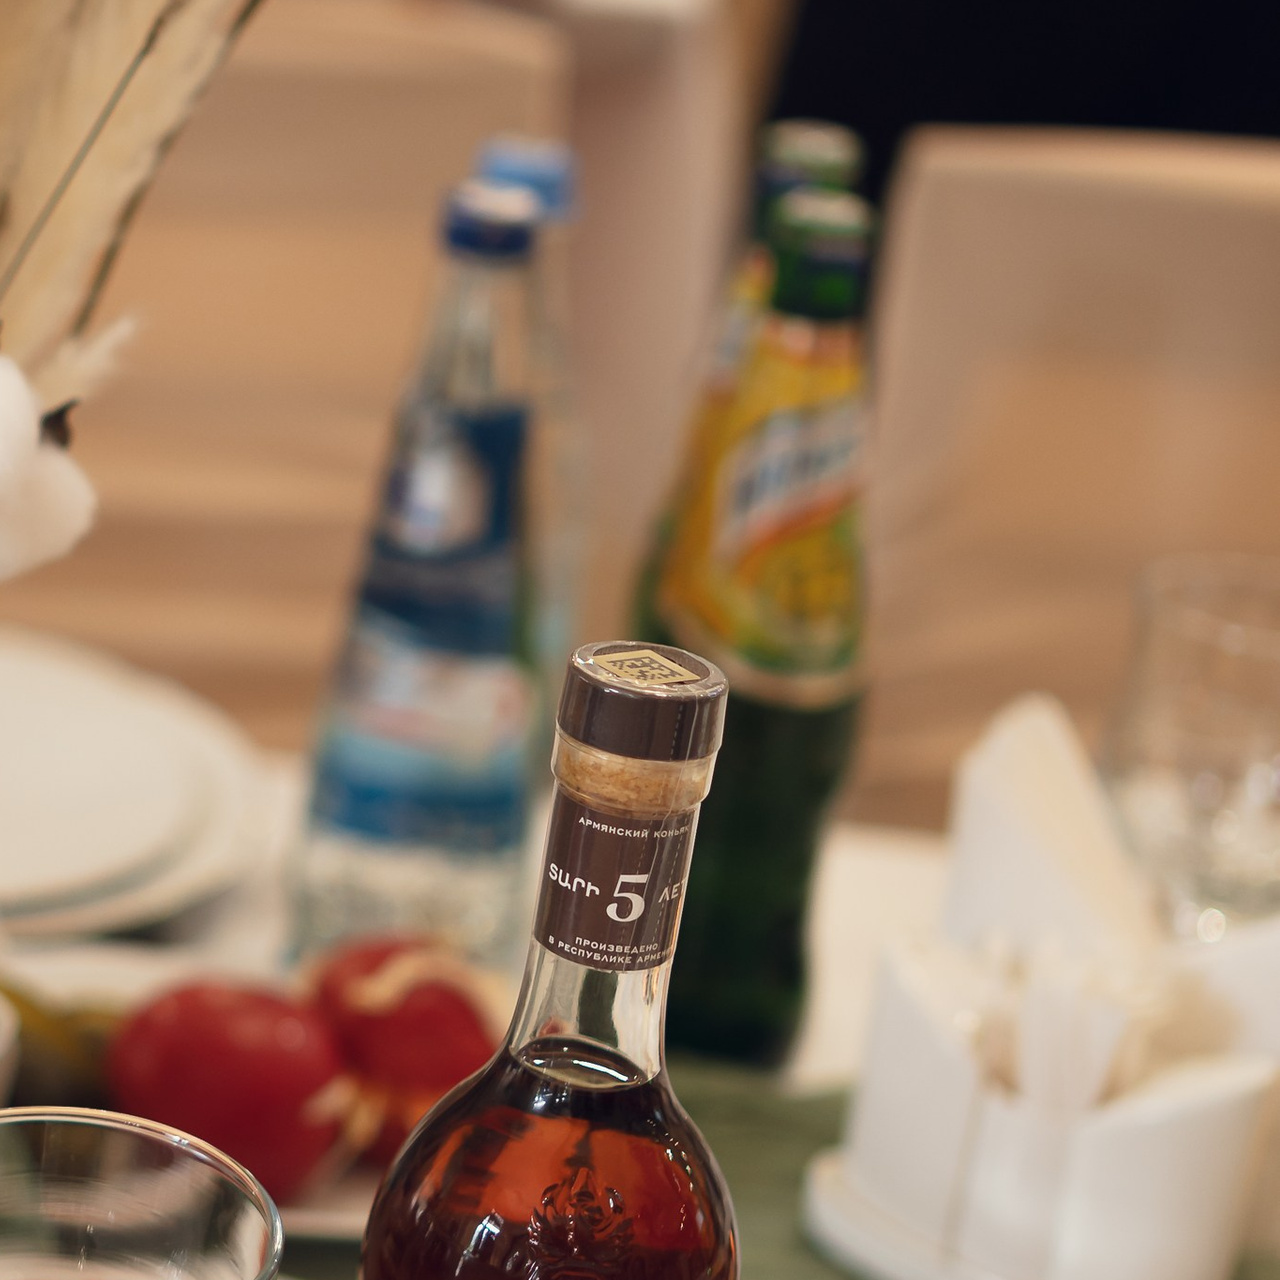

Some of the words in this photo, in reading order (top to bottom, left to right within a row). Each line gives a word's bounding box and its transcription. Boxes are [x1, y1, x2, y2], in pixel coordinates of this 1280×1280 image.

[578, 816, 649, 838] АРМЯНСКИЙ
[653, 824, 690, 838] КОНЬЯК
[605, 873, 649, 923] 5
[548, 934, 555, 944] В
[557, 940, 632, 964] РЕСПУБЛИКЕ
[575, 936, 659, 954] ПРОИЗВЕДЕНО
